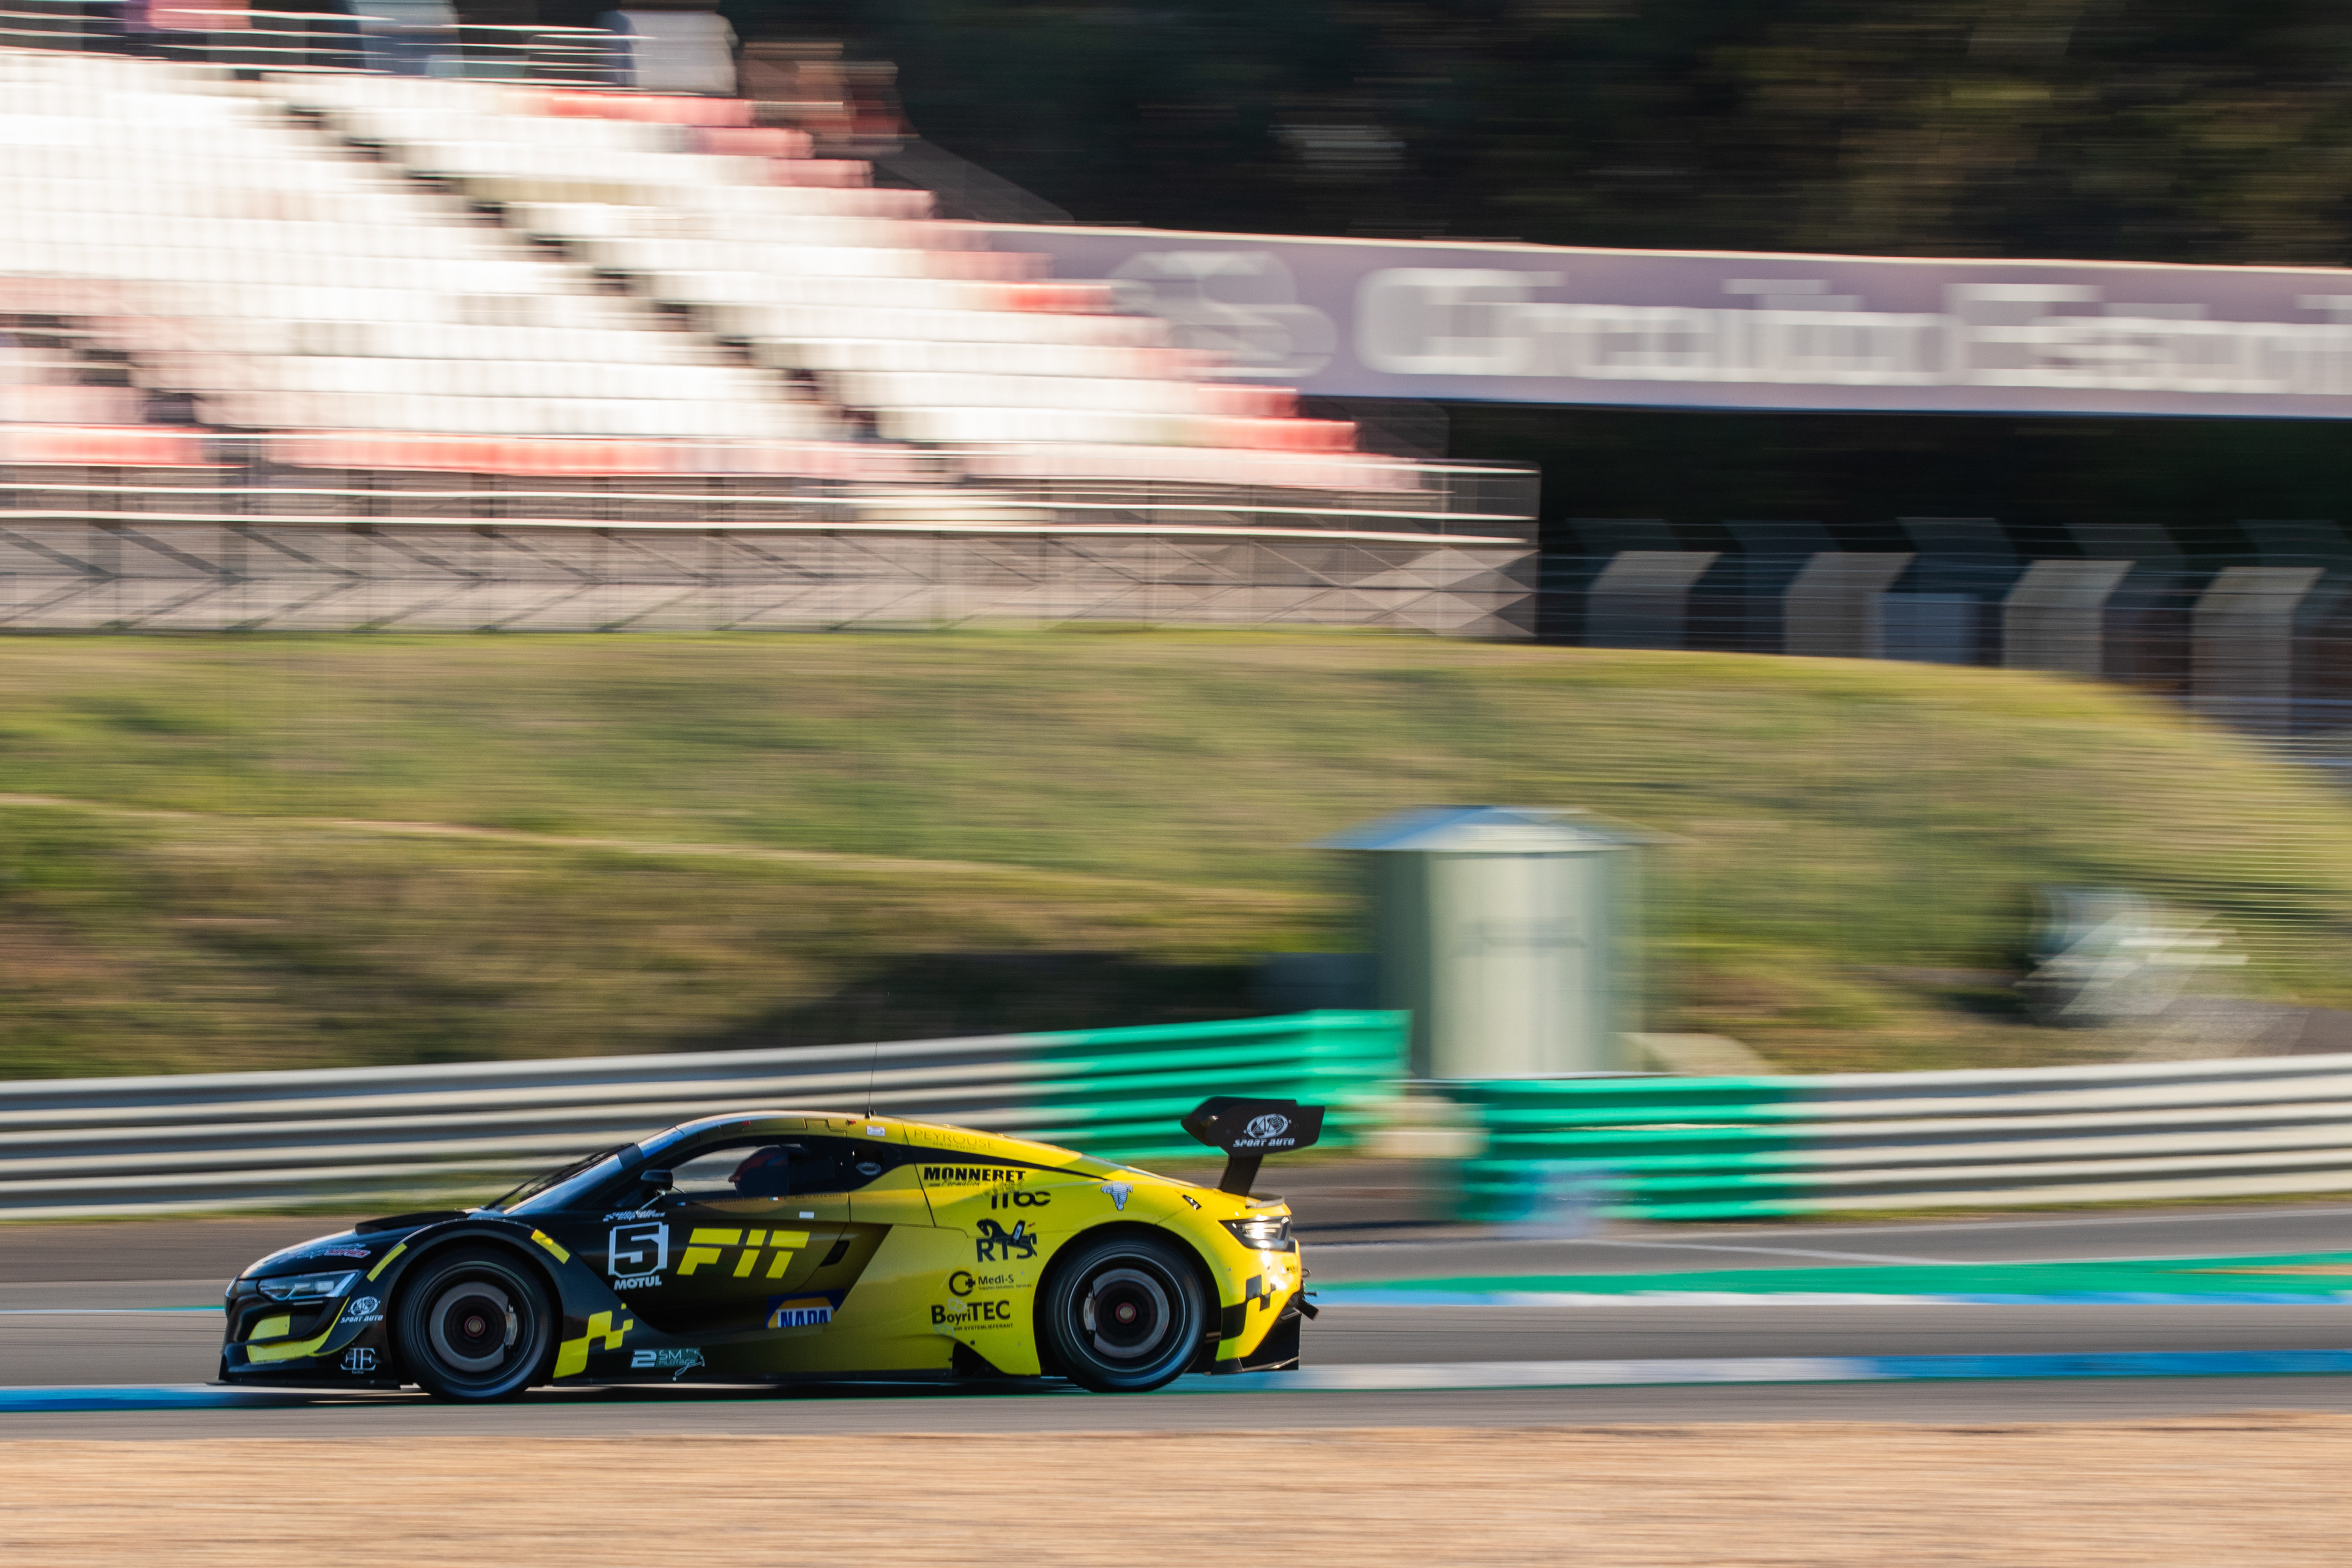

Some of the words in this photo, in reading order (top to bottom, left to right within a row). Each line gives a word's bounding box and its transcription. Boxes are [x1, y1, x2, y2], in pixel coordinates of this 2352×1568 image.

[914, 1129, 996, 1150] PEYROUSE
[1233, 1139, 1267, 1147] SPORT
[1268, 1138, 1295, 1147] AUTO
[924, 1166, 1026, 1182] MONNERET
[677, 1228, 810, 1279] FIT
[976, 1235, 1034, 1263] RTS
[614, 1275, 662, 1291] MOTUL
[978, 1273, 1014, 1286] Medi-S
[931, 1300, 1011, 1325] BoyriTEC
[659, 1349, 682, 1360] SM
